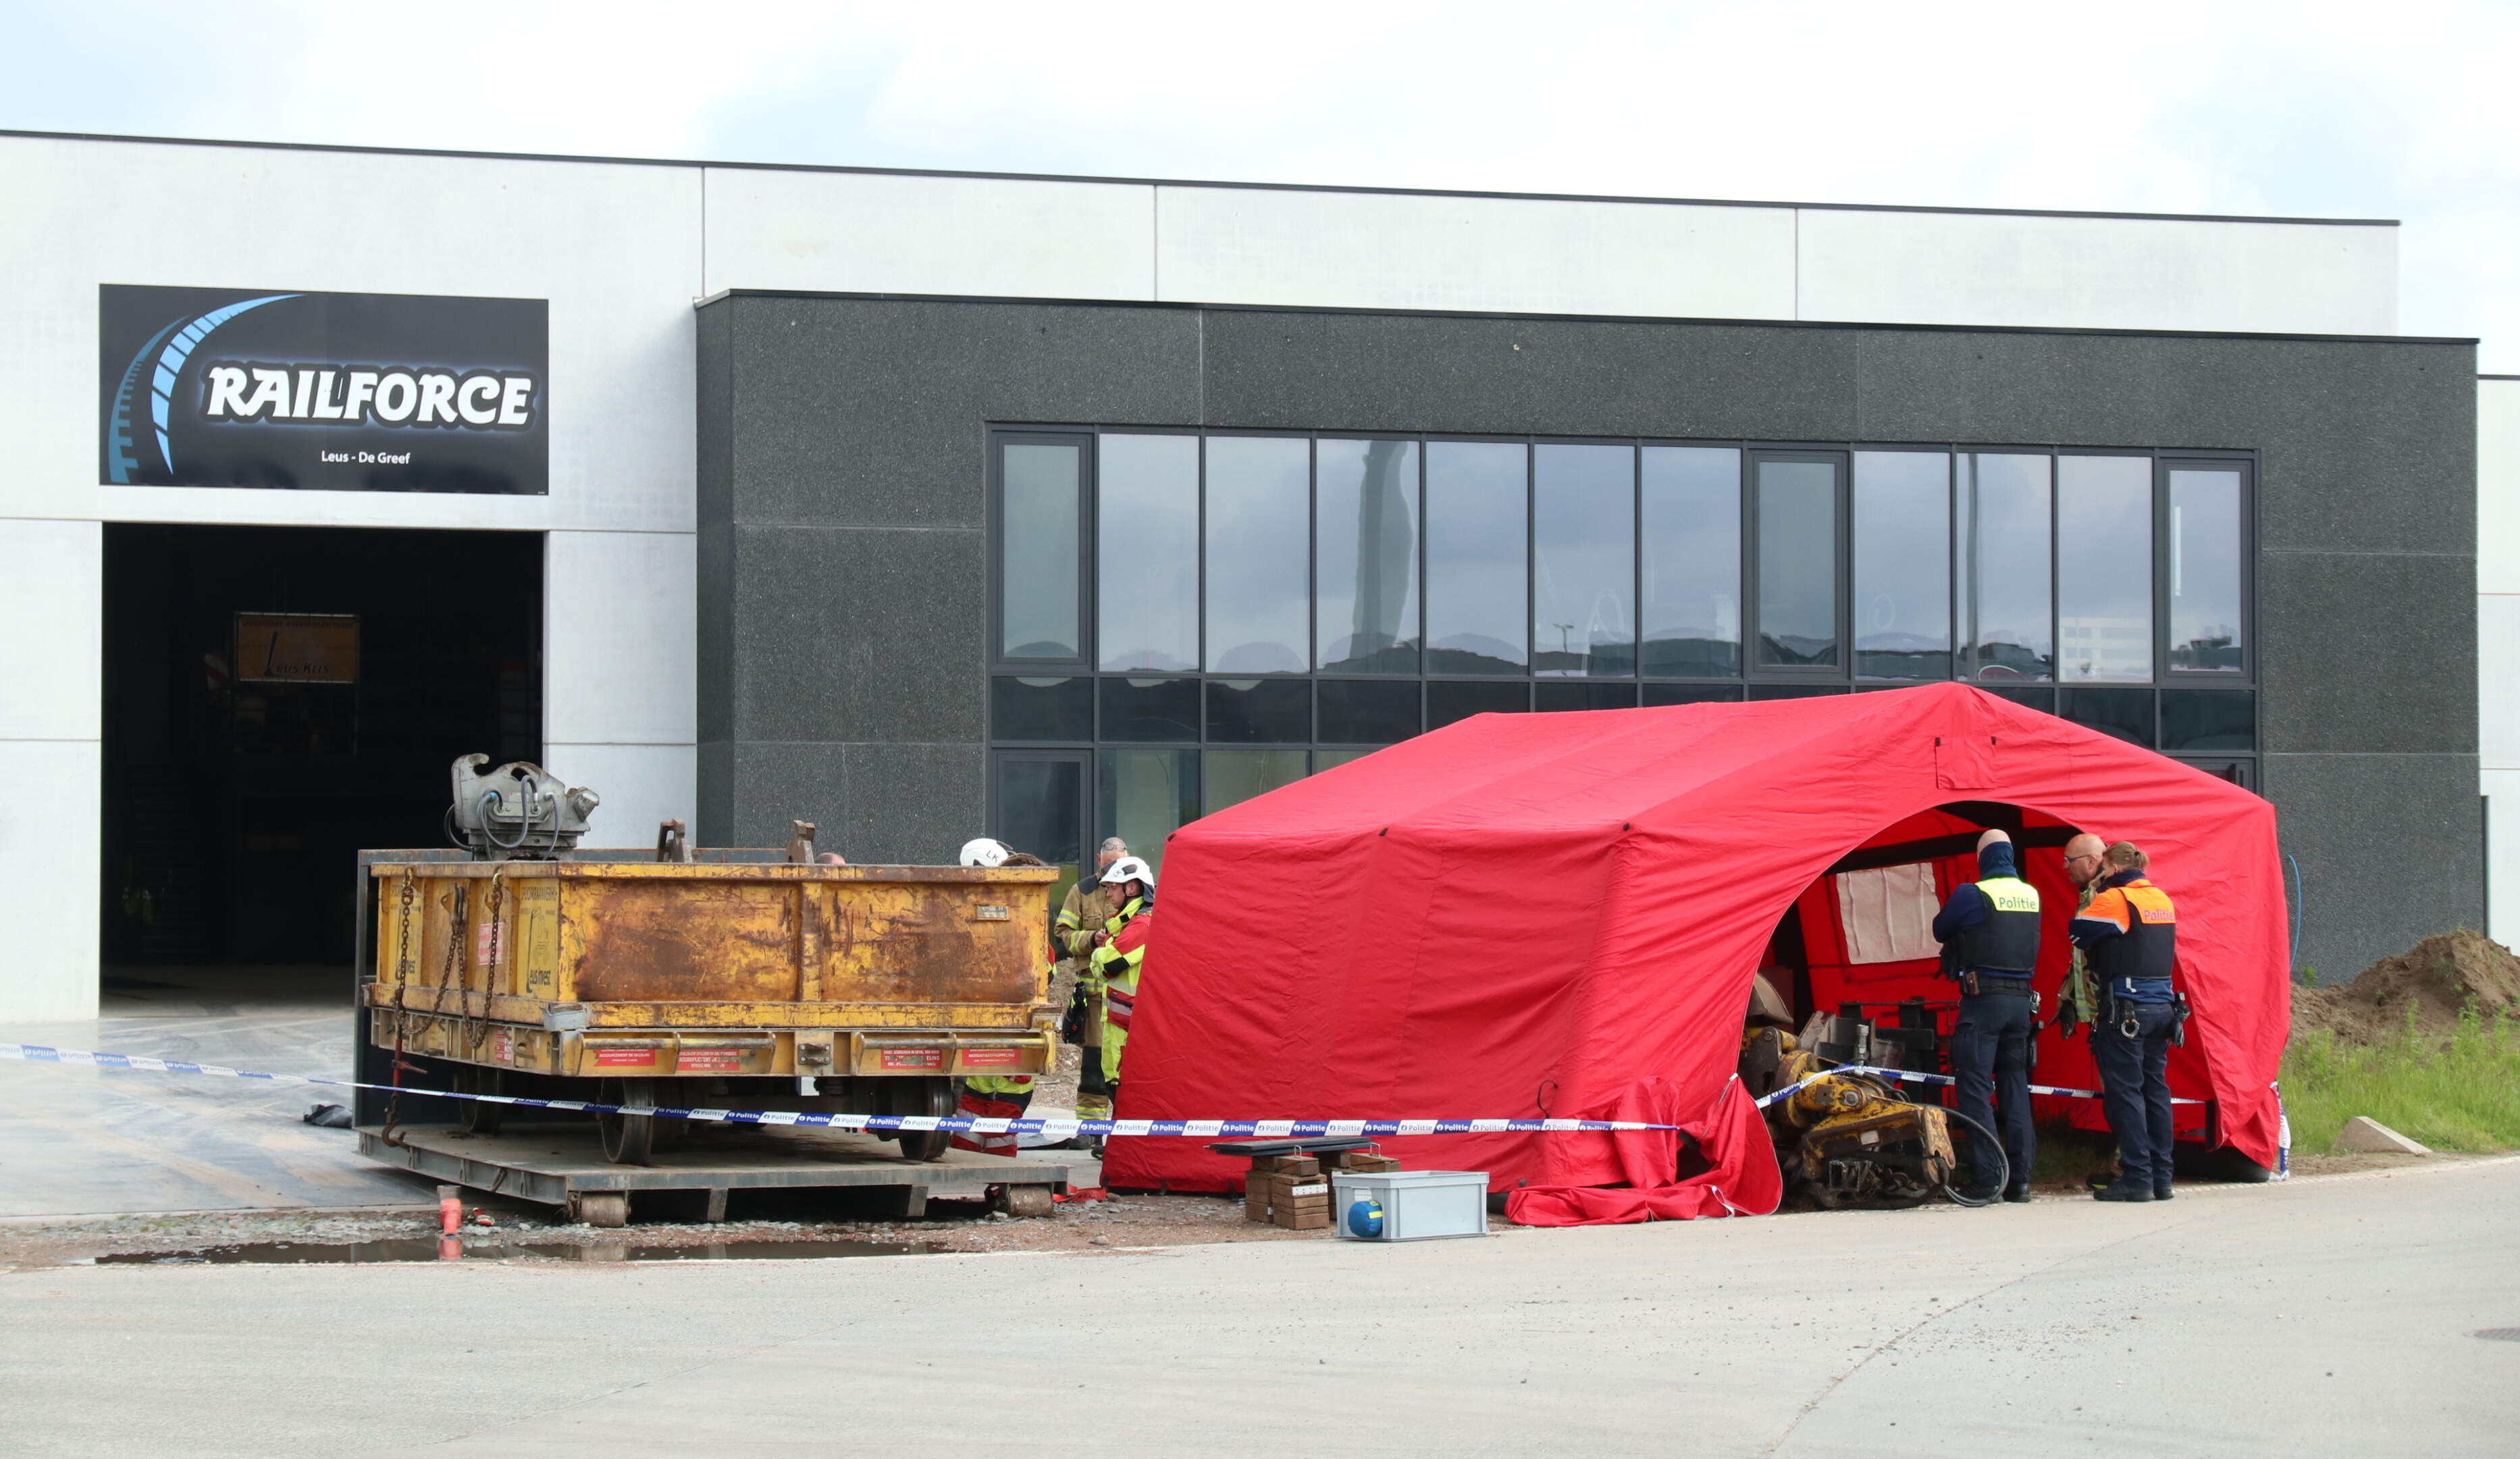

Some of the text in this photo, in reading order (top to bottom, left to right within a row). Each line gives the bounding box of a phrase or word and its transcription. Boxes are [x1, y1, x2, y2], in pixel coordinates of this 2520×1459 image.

[207, 367, 531, 425] RAILFORCE
[321, 450, 348, 463] Leus
[359, 451, 375, 463] De
[377, 452, 411, 465] Greef
[1999, 897, 2036, 910] Politie
[2145, 910, 2174, 922] Politie
[1018, 1122, 1042, 1130] Politie
[1088, 1123, 1113, 1131] Politie
[1230, 1124, 1255, 1132] Politie
[1301, 1124, 1325, 1132] Politie
[1373, 1124, 1397, 1132] Politie
